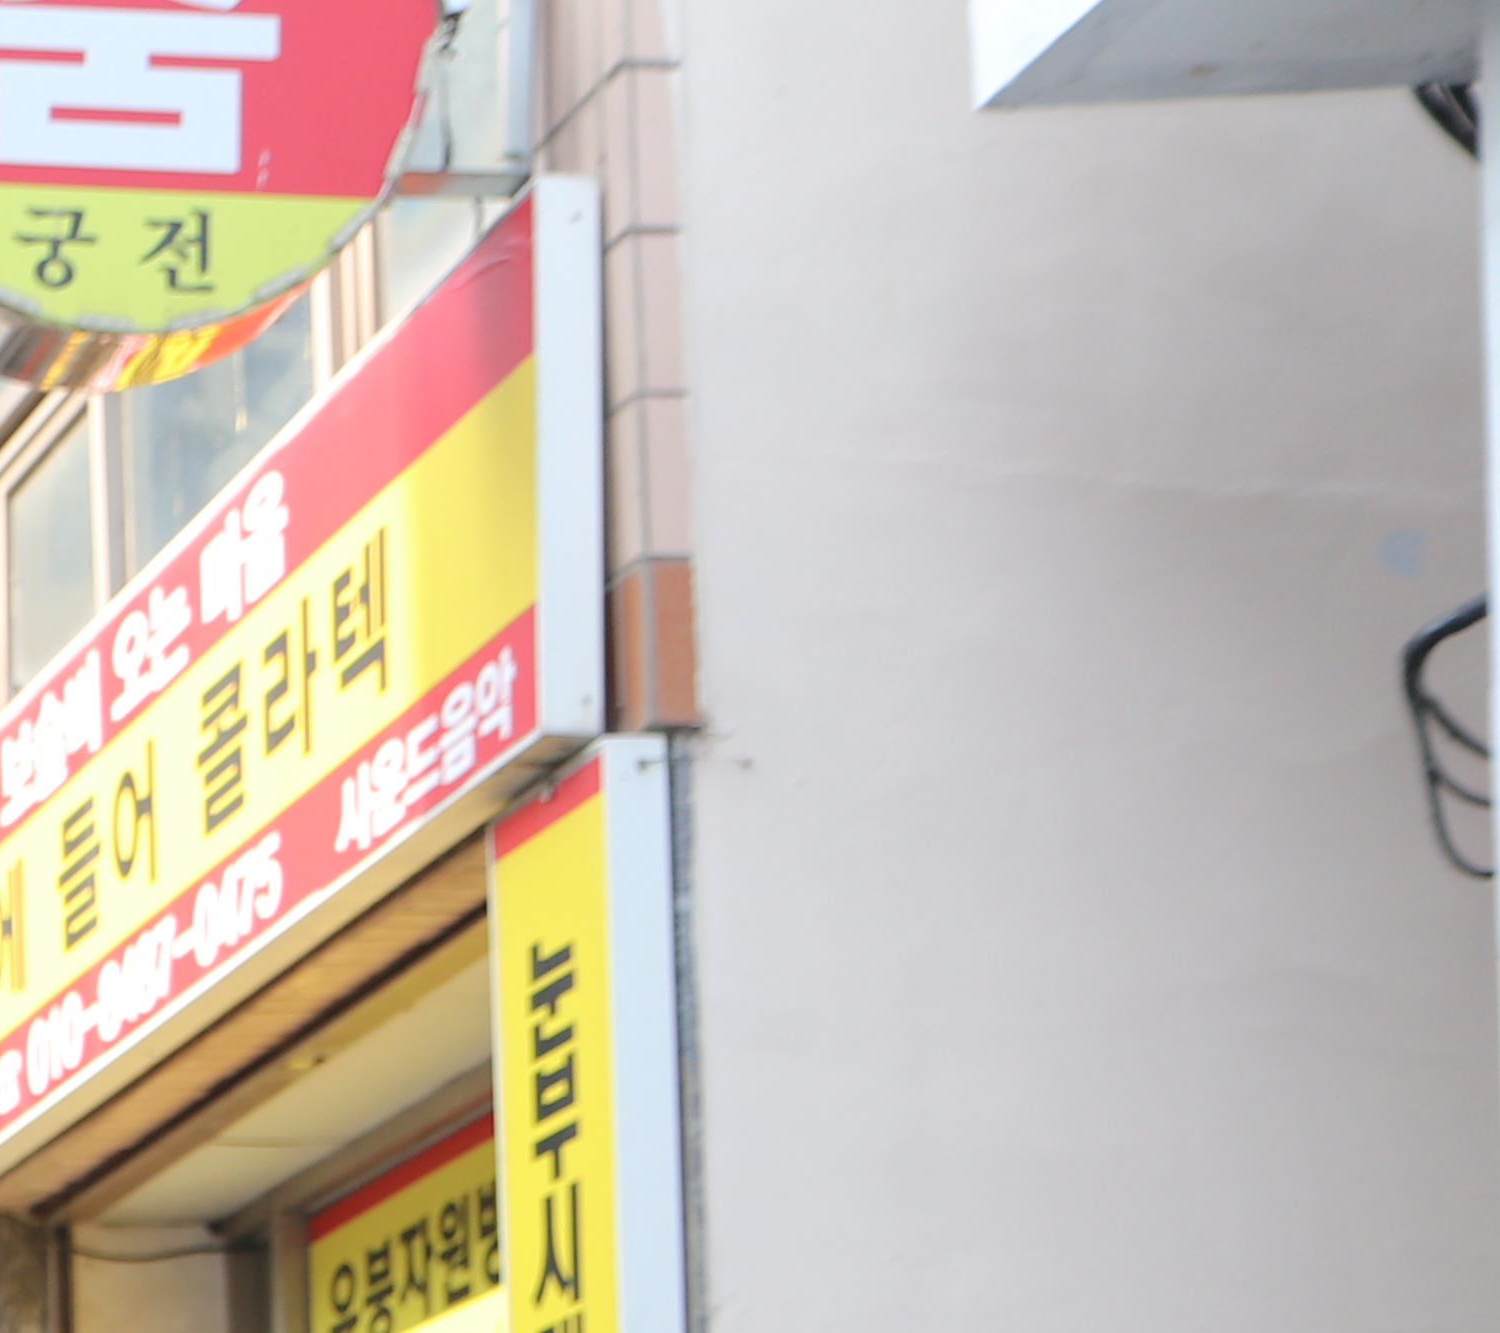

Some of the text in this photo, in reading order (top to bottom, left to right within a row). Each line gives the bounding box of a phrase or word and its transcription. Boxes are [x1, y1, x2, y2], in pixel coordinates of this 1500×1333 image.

[58, 738, 158, 955] 들어
[198, 525, 388, 836] 콜라텍
[110, 585, 192, 723] 오는
